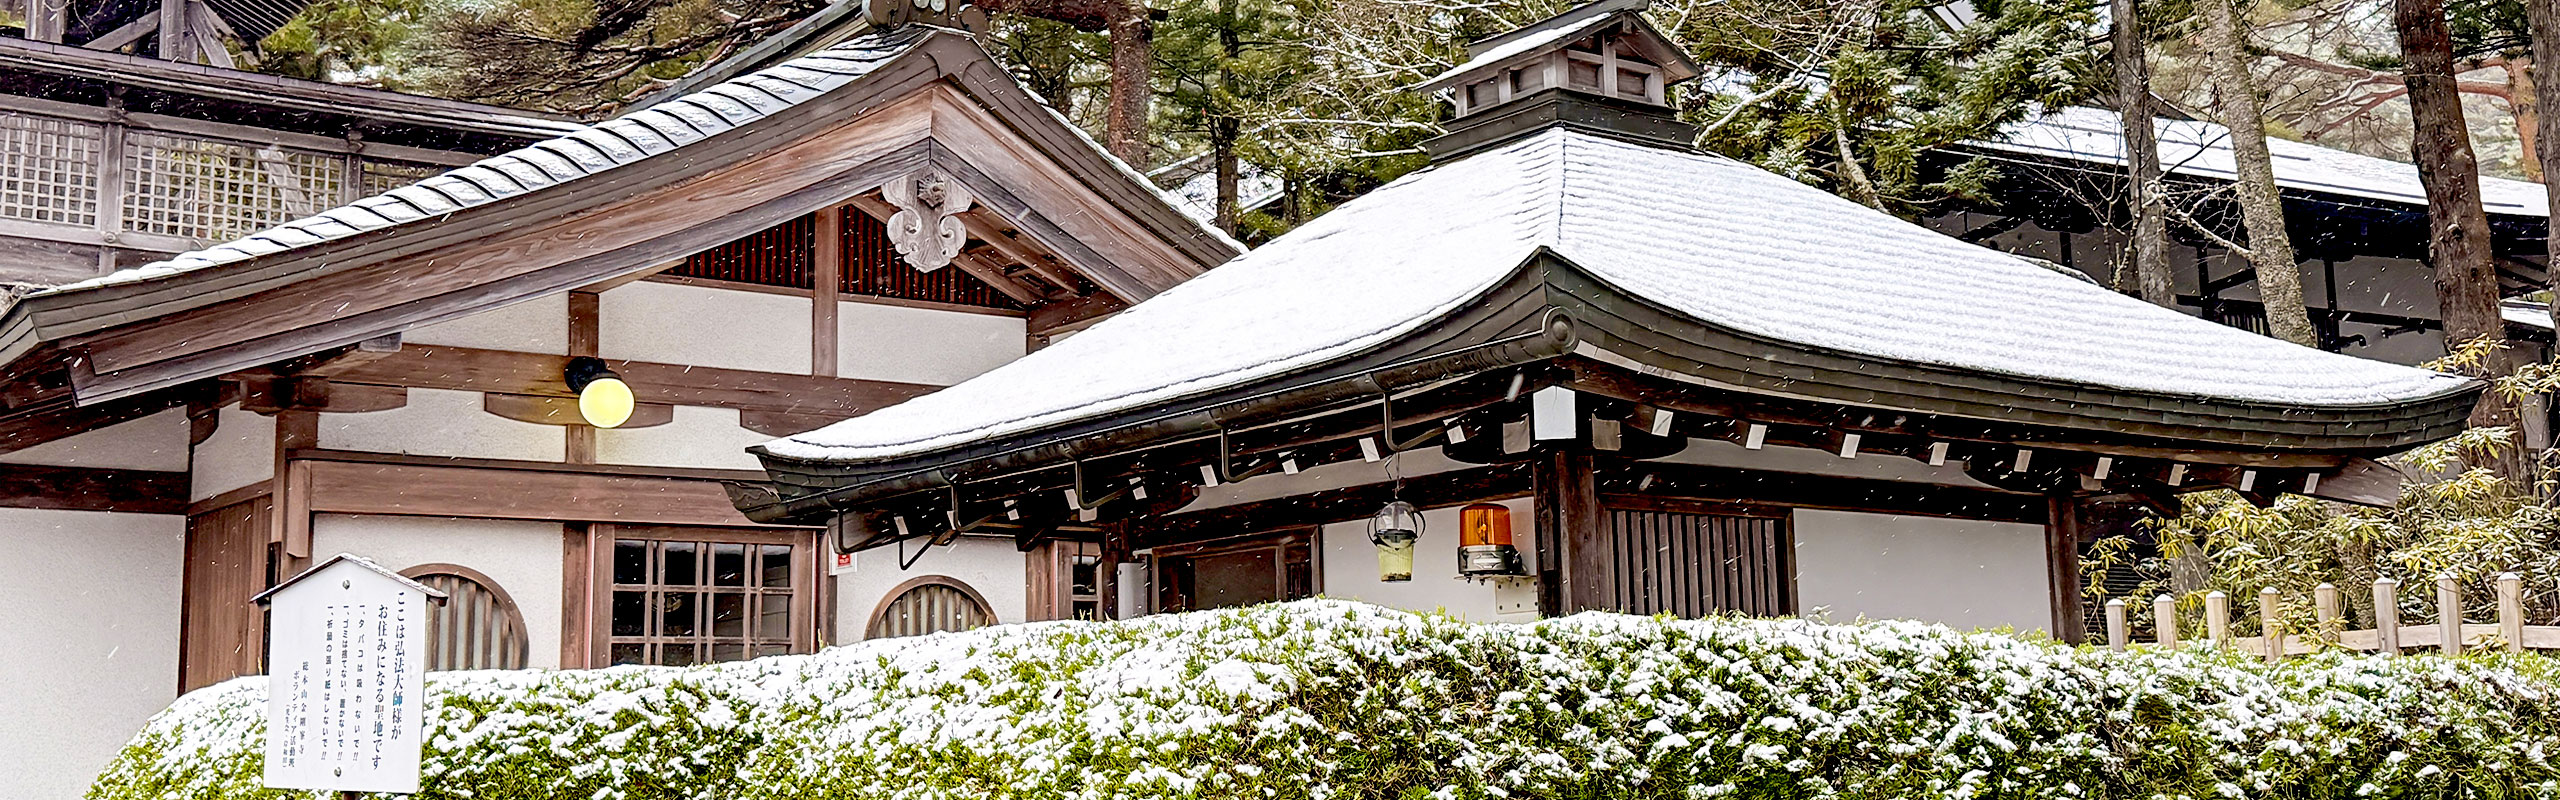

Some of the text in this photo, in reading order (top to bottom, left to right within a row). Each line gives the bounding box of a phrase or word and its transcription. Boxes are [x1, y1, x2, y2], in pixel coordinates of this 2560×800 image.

[372, 604, 388, 769] お住みになる聖地です
[391, 592, 405, 740] ここは弘法大師様が
